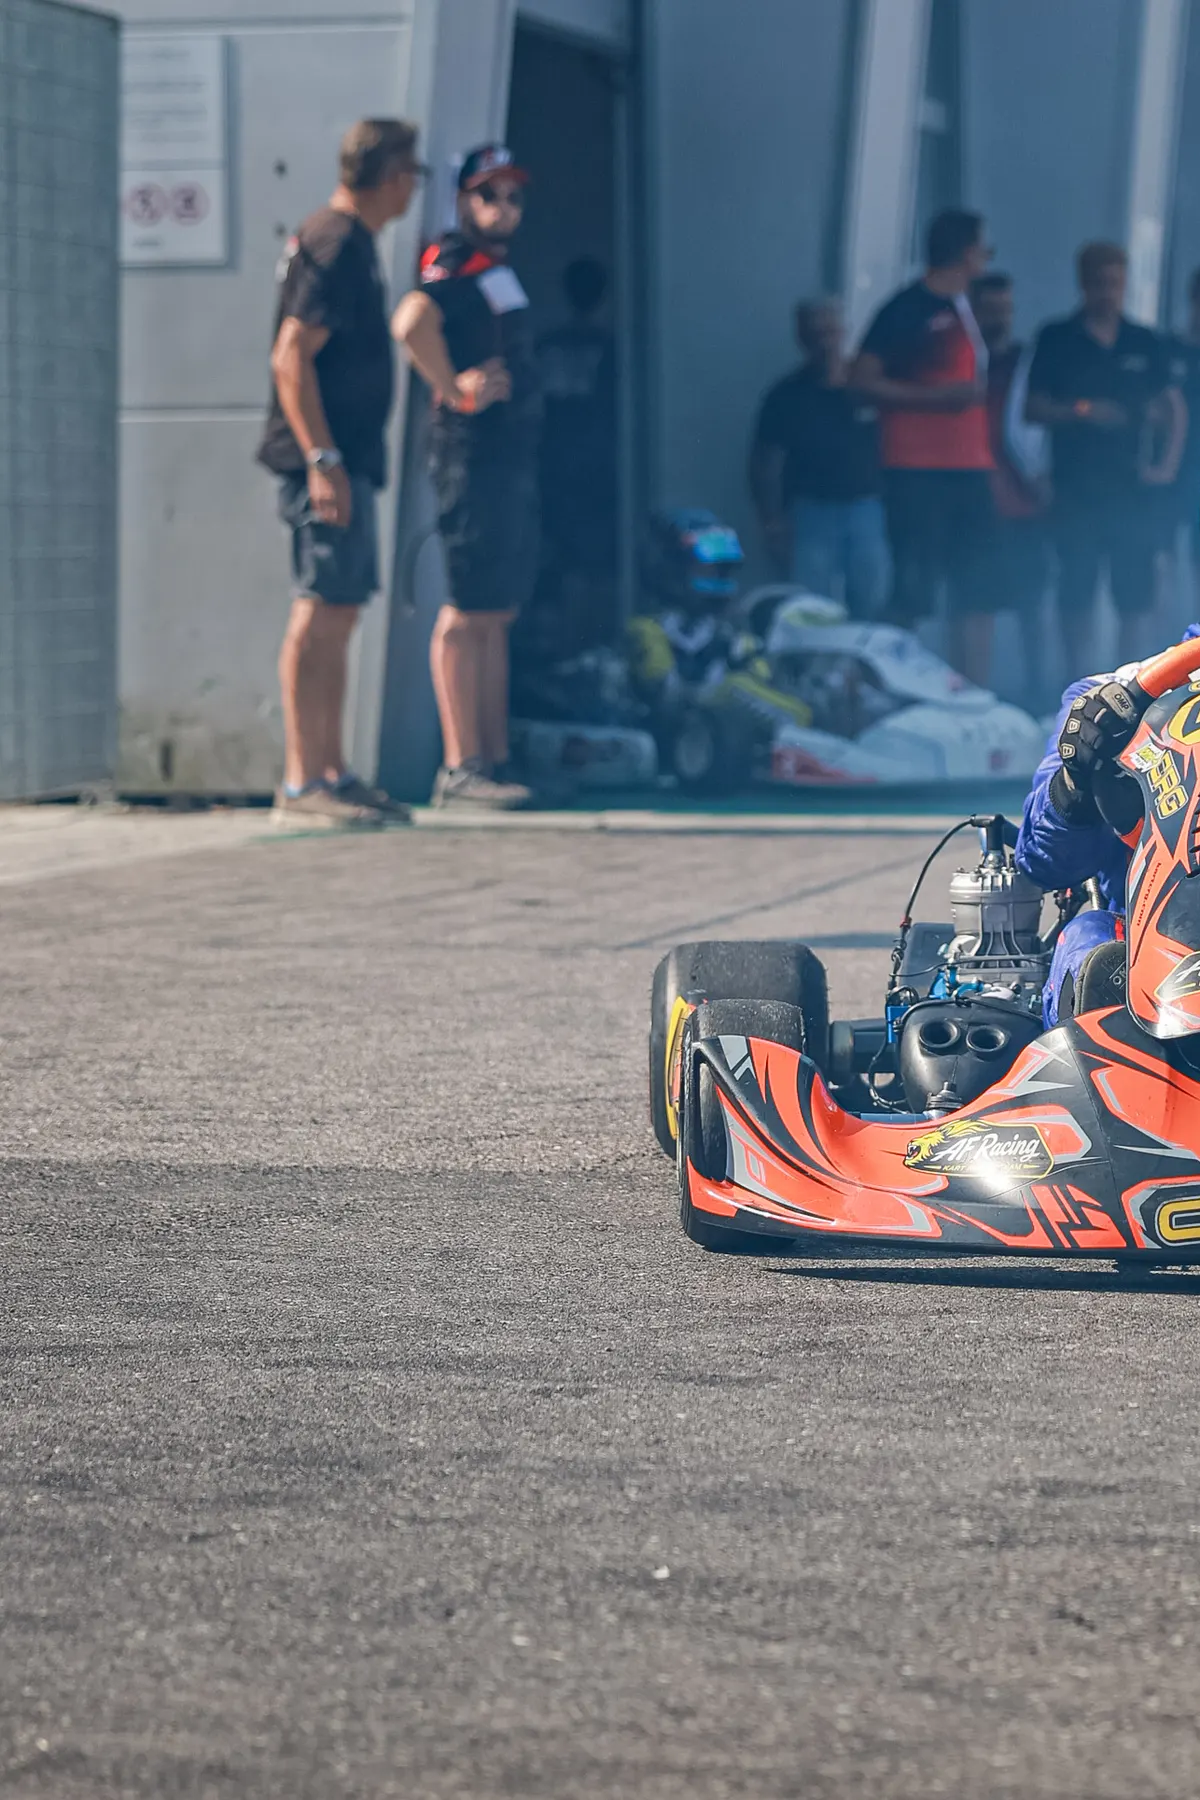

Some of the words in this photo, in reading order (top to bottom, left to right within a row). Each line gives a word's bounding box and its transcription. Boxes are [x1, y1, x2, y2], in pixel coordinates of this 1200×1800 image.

[1113, 692, 1131, 711] OMP
[930, 1136, 981, 1161] AF
[972, 1133, 1040, 1162] Racing
